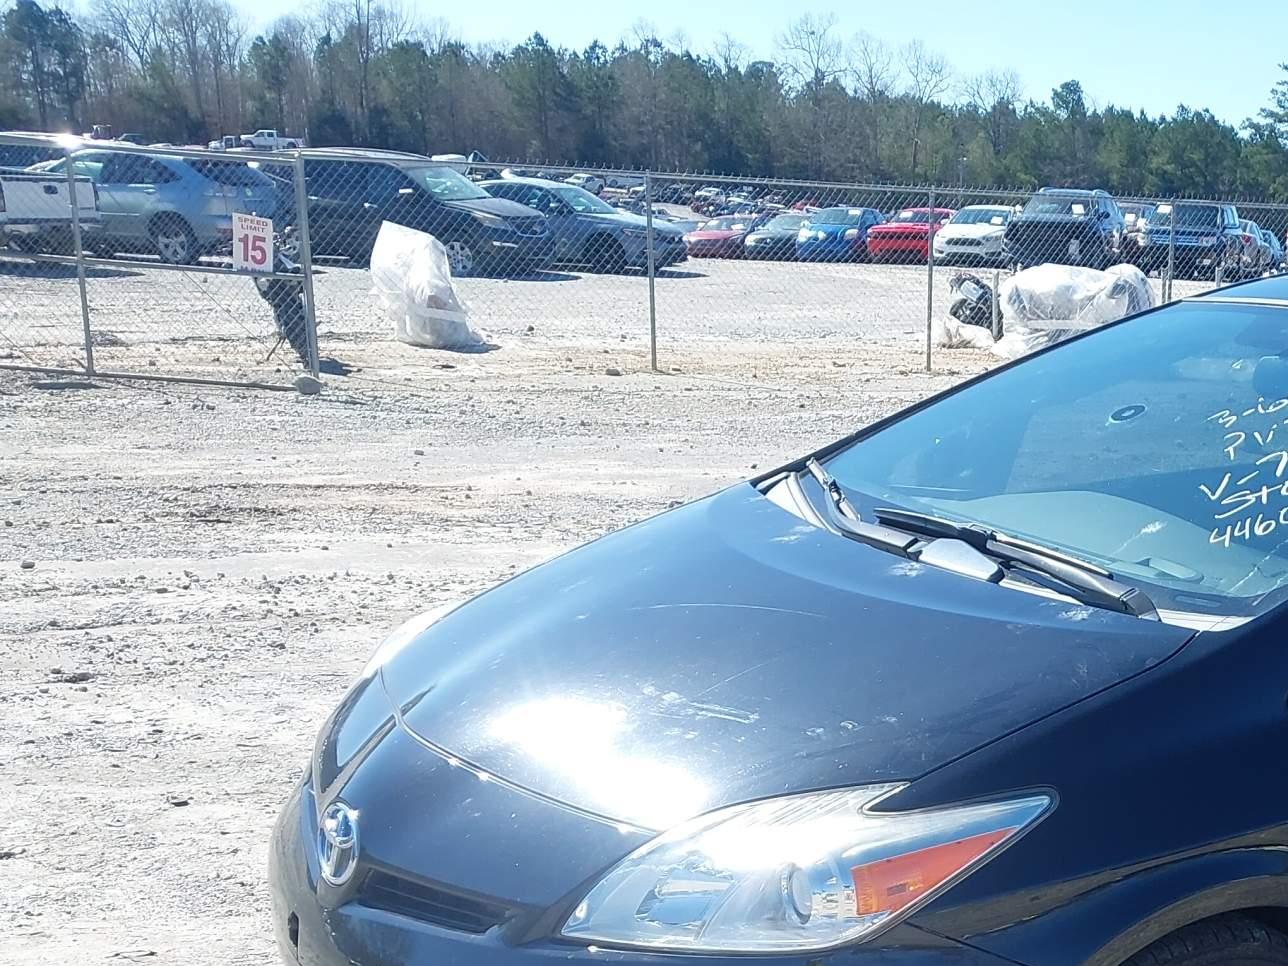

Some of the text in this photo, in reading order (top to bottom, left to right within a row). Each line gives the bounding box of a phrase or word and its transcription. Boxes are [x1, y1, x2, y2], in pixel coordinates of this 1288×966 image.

[238, 216, 269, 227] SPEED
[241, 224, 266, 233] LIMIT
[238, 233, 267, 265] 15
